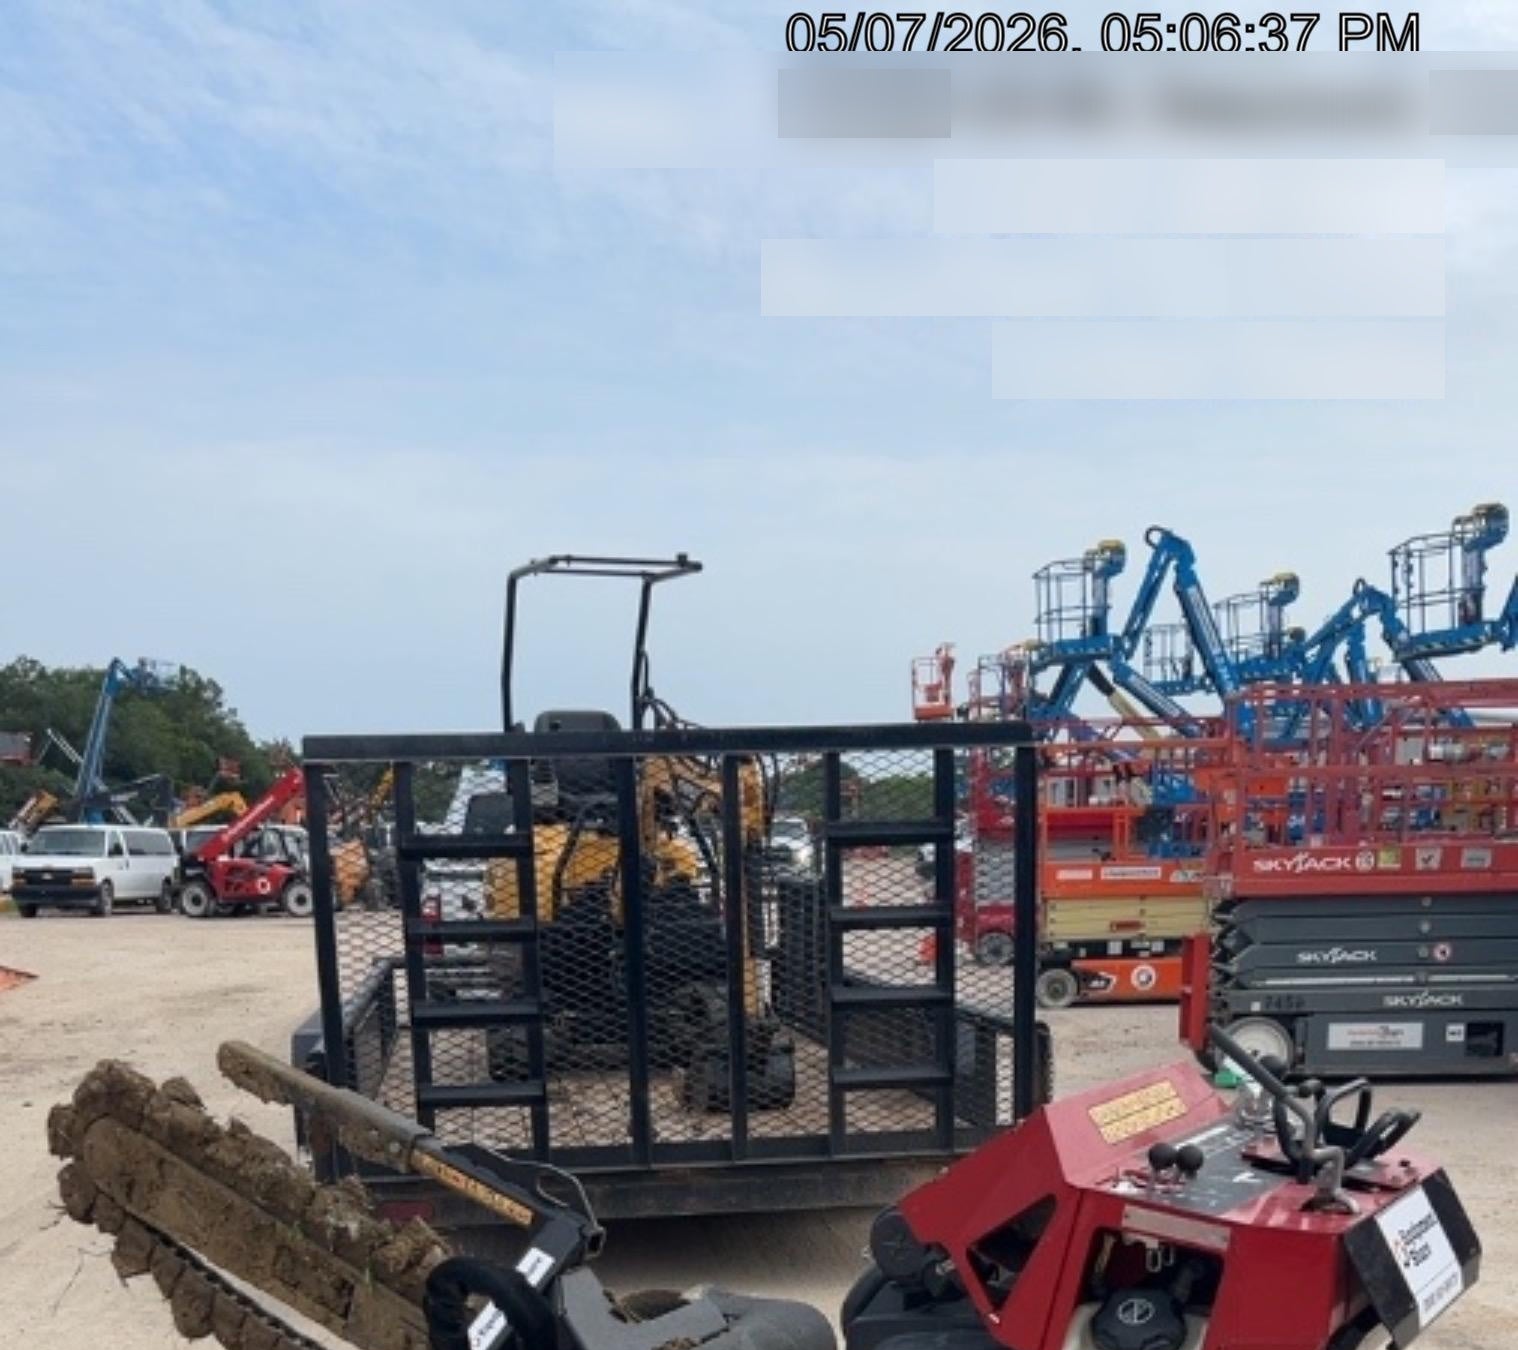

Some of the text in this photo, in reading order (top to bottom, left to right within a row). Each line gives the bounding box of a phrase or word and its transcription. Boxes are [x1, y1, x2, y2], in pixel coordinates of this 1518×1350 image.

[1253, 852, 1351, 873] SKYJACK
[1297, 948, 1377, 963] SKYJACK
[1382, 989, 1464, 1007] SKYJACK
